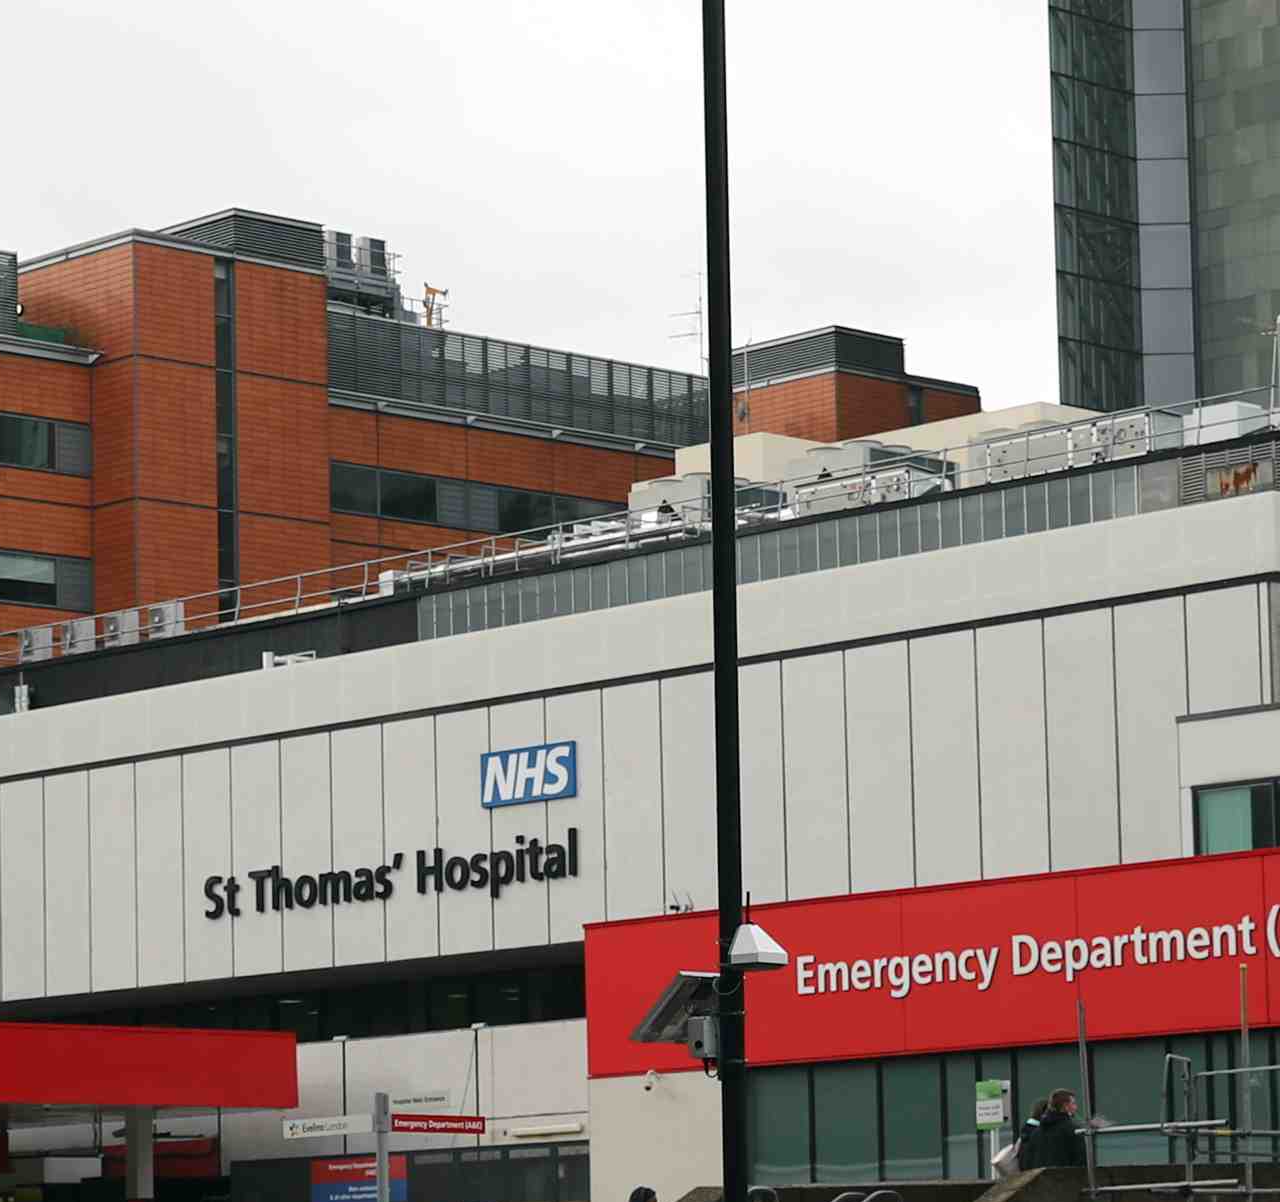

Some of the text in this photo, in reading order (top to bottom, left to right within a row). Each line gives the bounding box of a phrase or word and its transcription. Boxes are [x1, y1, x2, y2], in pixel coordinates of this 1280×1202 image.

[483, 744, 571, 804] NHS
[204, 874, 241, 920] St
[416, 827, 579, 899] Hospital
[796, 944, 1000, 1000] Emergency
[1011, 914, 1256, 984] Department
[394, 1119, 428, 1130] Emergency
